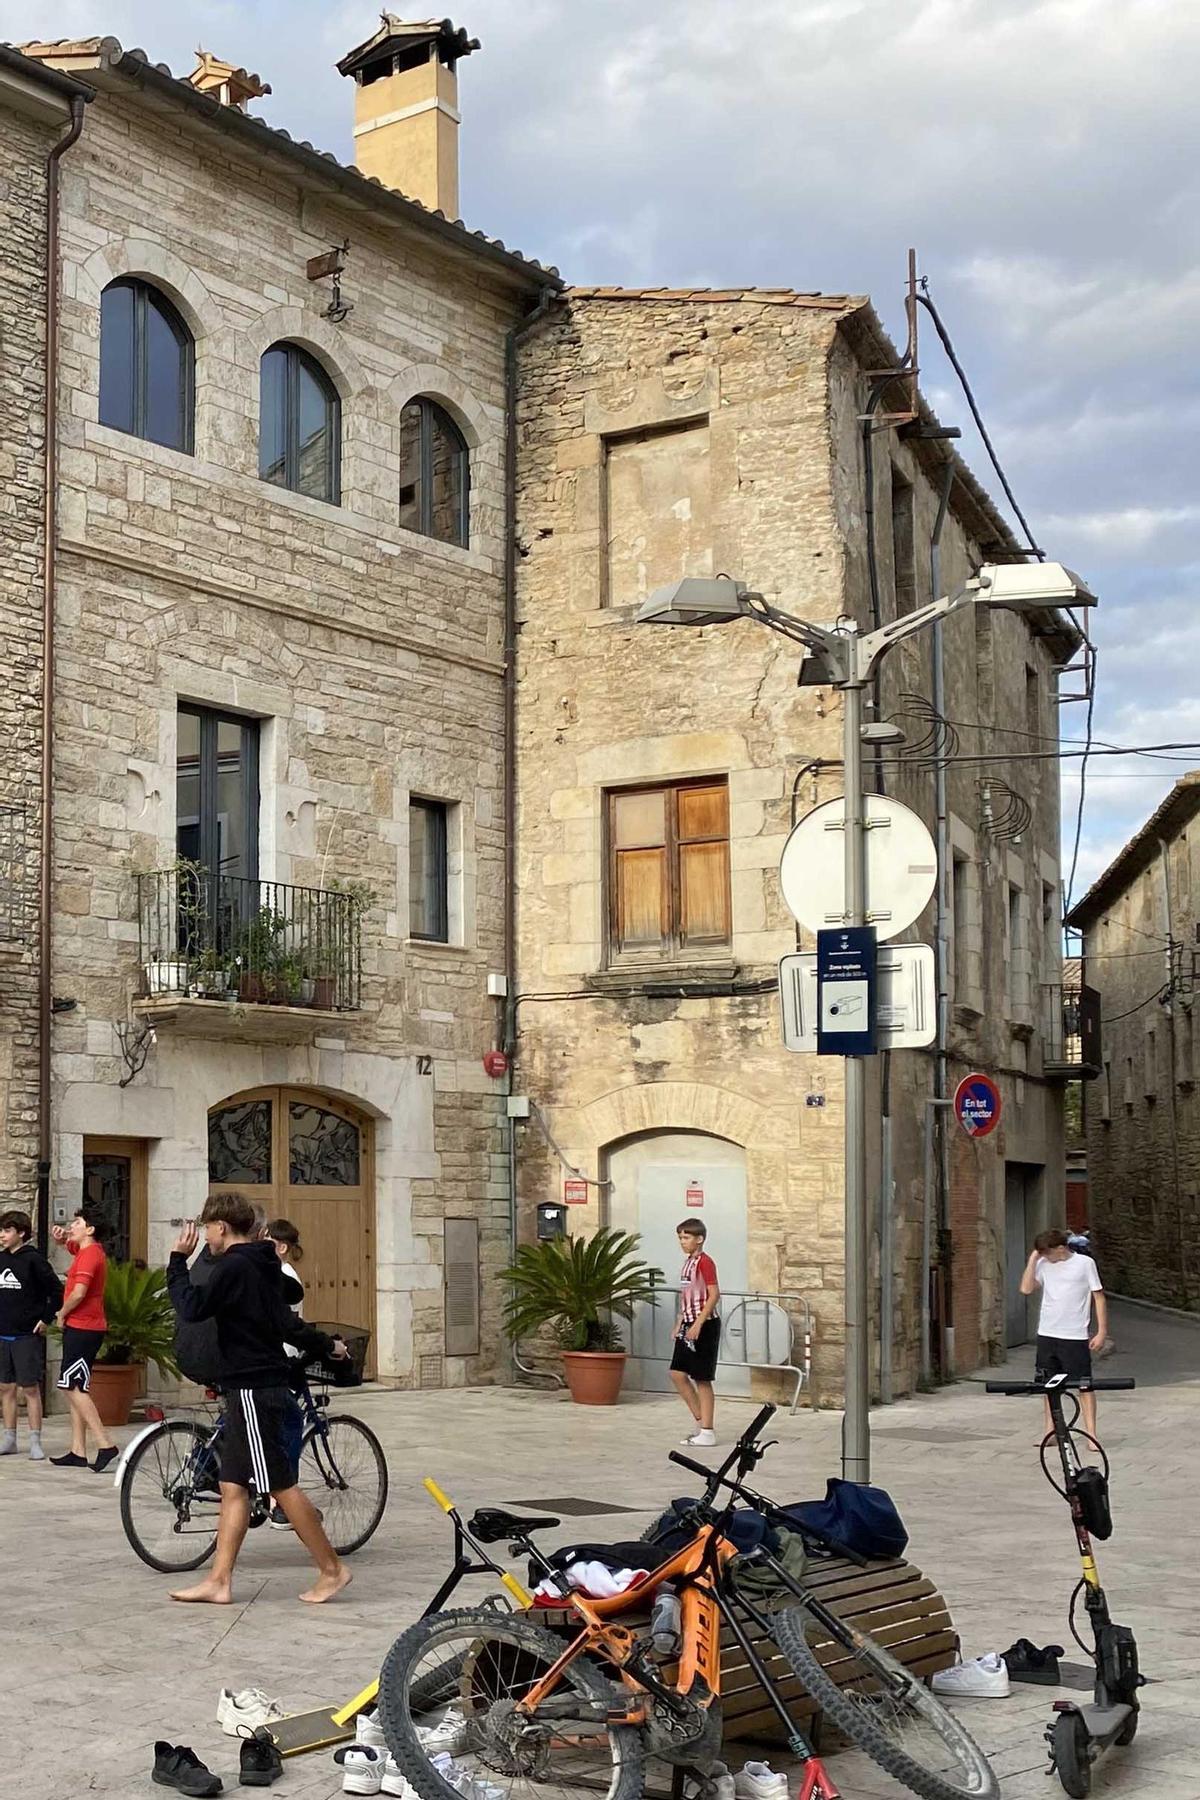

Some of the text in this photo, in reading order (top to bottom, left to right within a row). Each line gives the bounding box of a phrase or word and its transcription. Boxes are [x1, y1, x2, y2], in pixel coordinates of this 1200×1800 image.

[416, 1054, 432, 1076] 12
[965, 1098, 987, 1108] En tot
[961, 1109, 993, 1118] el sector
